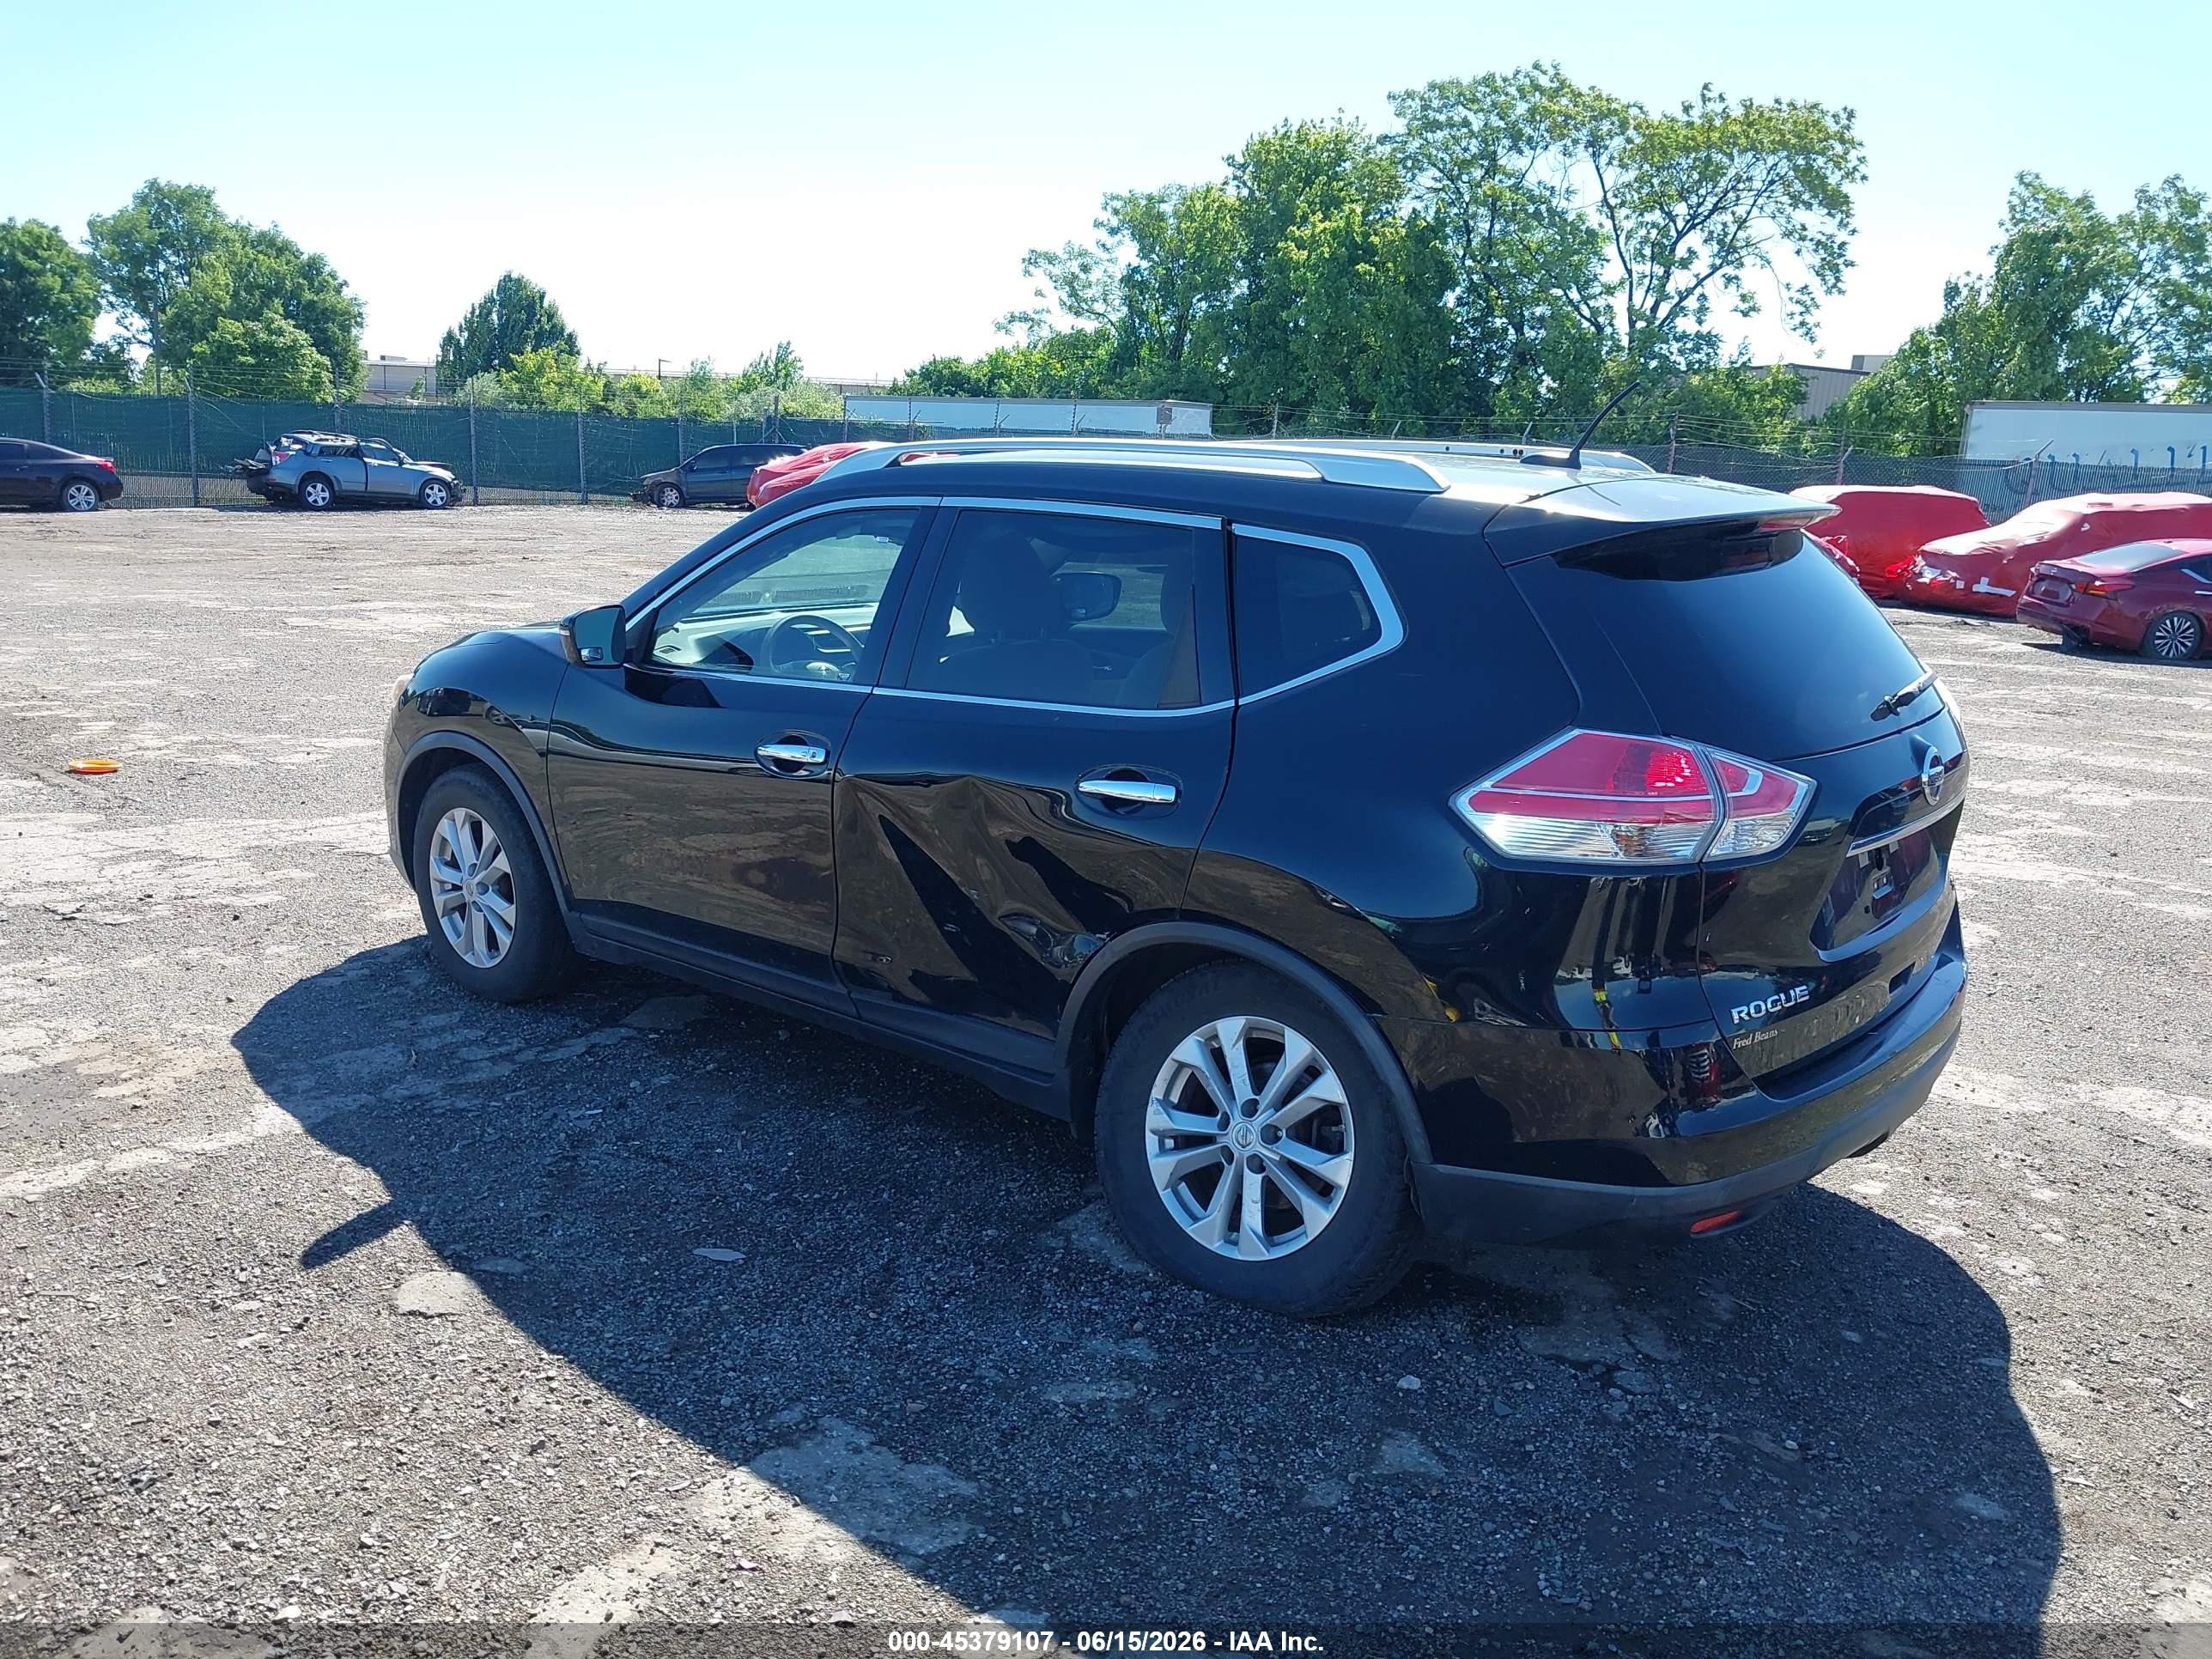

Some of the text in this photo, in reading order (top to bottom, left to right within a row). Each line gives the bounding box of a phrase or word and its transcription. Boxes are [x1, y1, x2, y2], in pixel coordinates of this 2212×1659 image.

[1730, 985, 1810, 1024] ROGUE
[1733, 1029, 1778, 1049] Fred Beans
